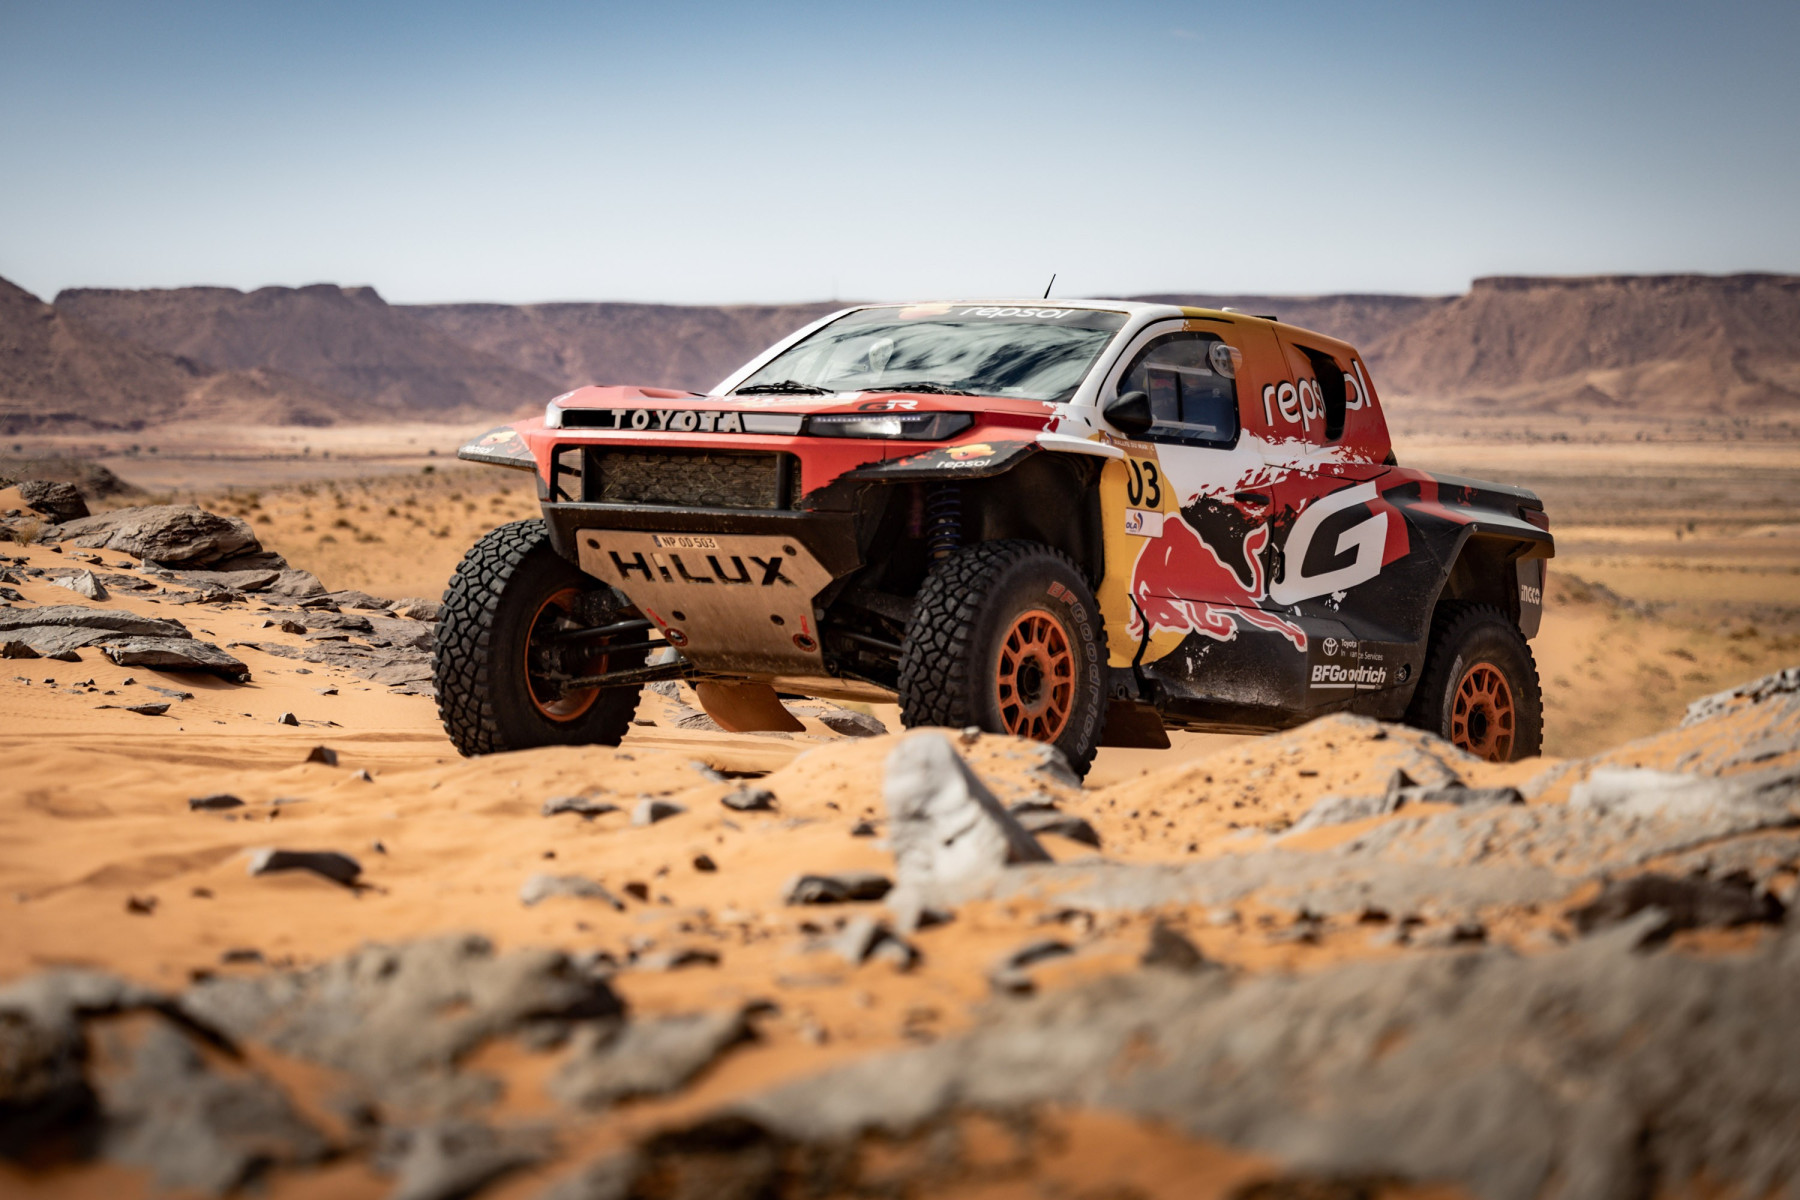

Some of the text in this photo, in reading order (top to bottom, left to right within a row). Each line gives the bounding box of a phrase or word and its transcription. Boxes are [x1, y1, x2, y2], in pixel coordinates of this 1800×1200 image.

[960, 306, 1075, 319] repsol
[858, 399, 919, 412] GR
[611, 408, 744, 433] TOYOTA
[936, 459, 991, 470] repsol
[1127, 458, 1161, 509] 03
[1125, 522, 1138, 530] OLA
[661, 536, 676, 547] NP
[694, 537, 716, 549] 503
[1341, 638, 1357, 649] Toyota
[1364, 651, 1384, 661] Services
[1047, 581, 1101, 756] BFGoodrich
[1311, 664, 1387, 684] BFGoodrich
